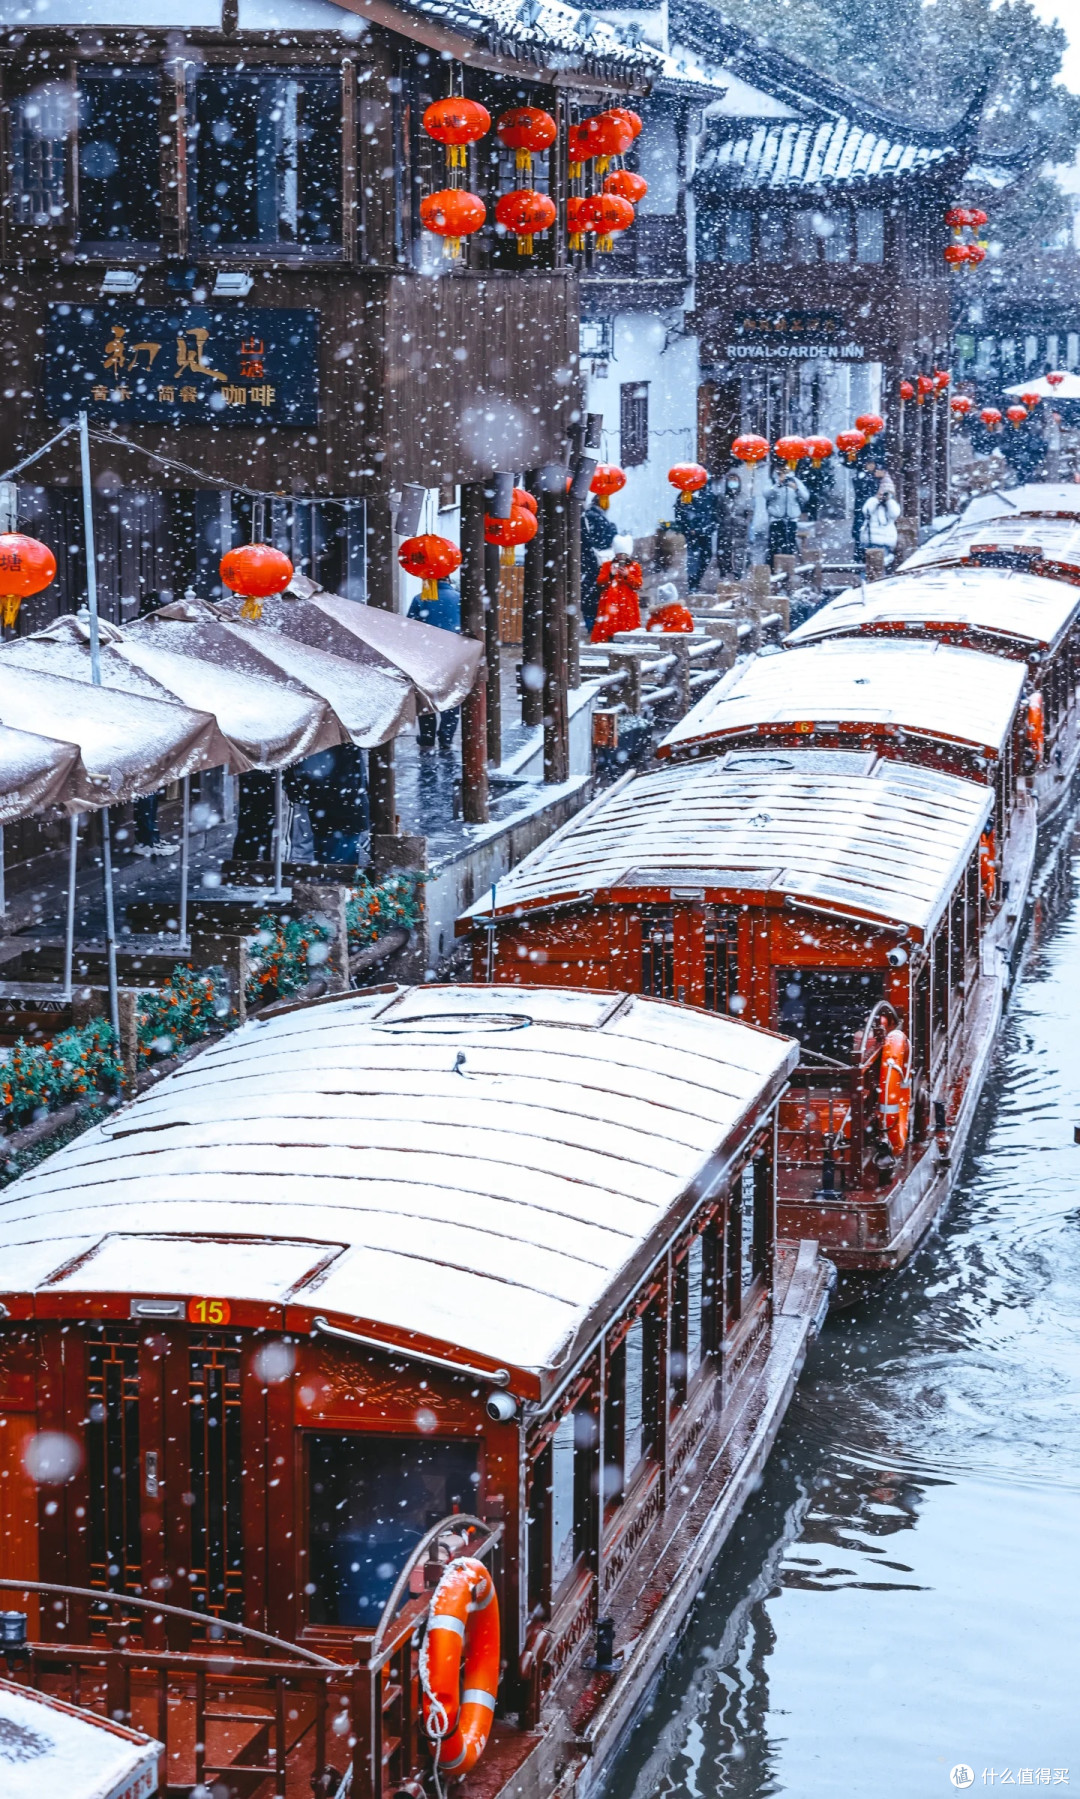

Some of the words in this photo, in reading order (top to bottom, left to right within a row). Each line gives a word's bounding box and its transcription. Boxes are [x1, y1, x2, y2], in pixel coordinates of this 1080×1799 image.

[104, 326, 228, 380] 初见
[240, 336, 264, 378] 山塘
[775, 345, 838, 357] GARDEN
[841, 345, 864, 357] INN
[158, 385, 198, 403] 简餐
[221, 384, 276, 407] 咖啡
[195, 1300, 223, 1324] 15
